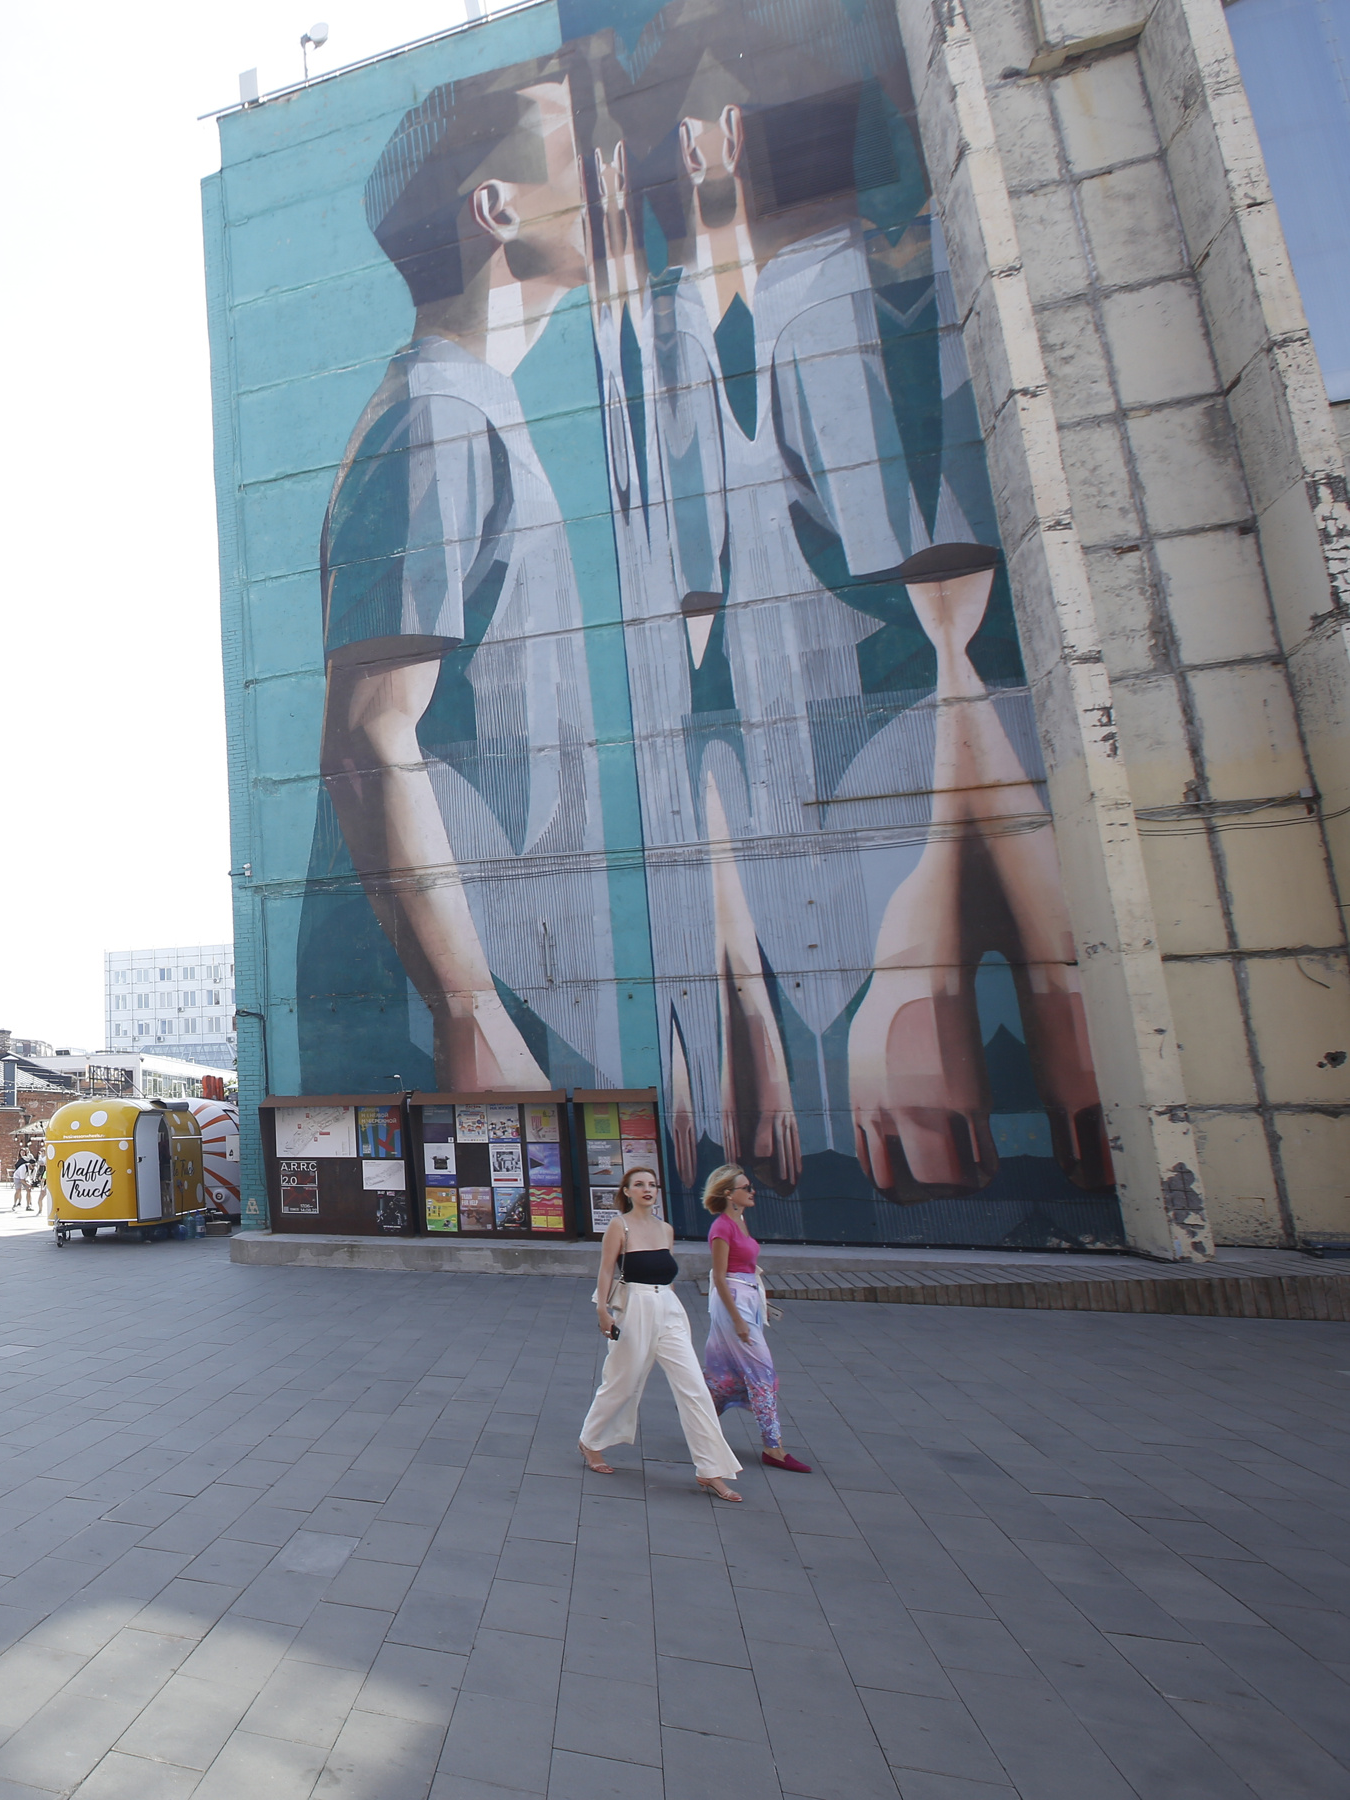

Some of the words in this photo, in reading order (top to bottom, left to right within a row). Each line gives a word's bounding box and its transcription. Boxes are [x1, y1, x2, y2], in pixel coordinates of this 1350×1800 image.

[57, 1158, 116, 1182] Waffle
[280, 1162, 318, 1172] A.R.R.C
[282, 1176, 298, 1186] 2.0
[66, 1179, 113, 1200] Truck
